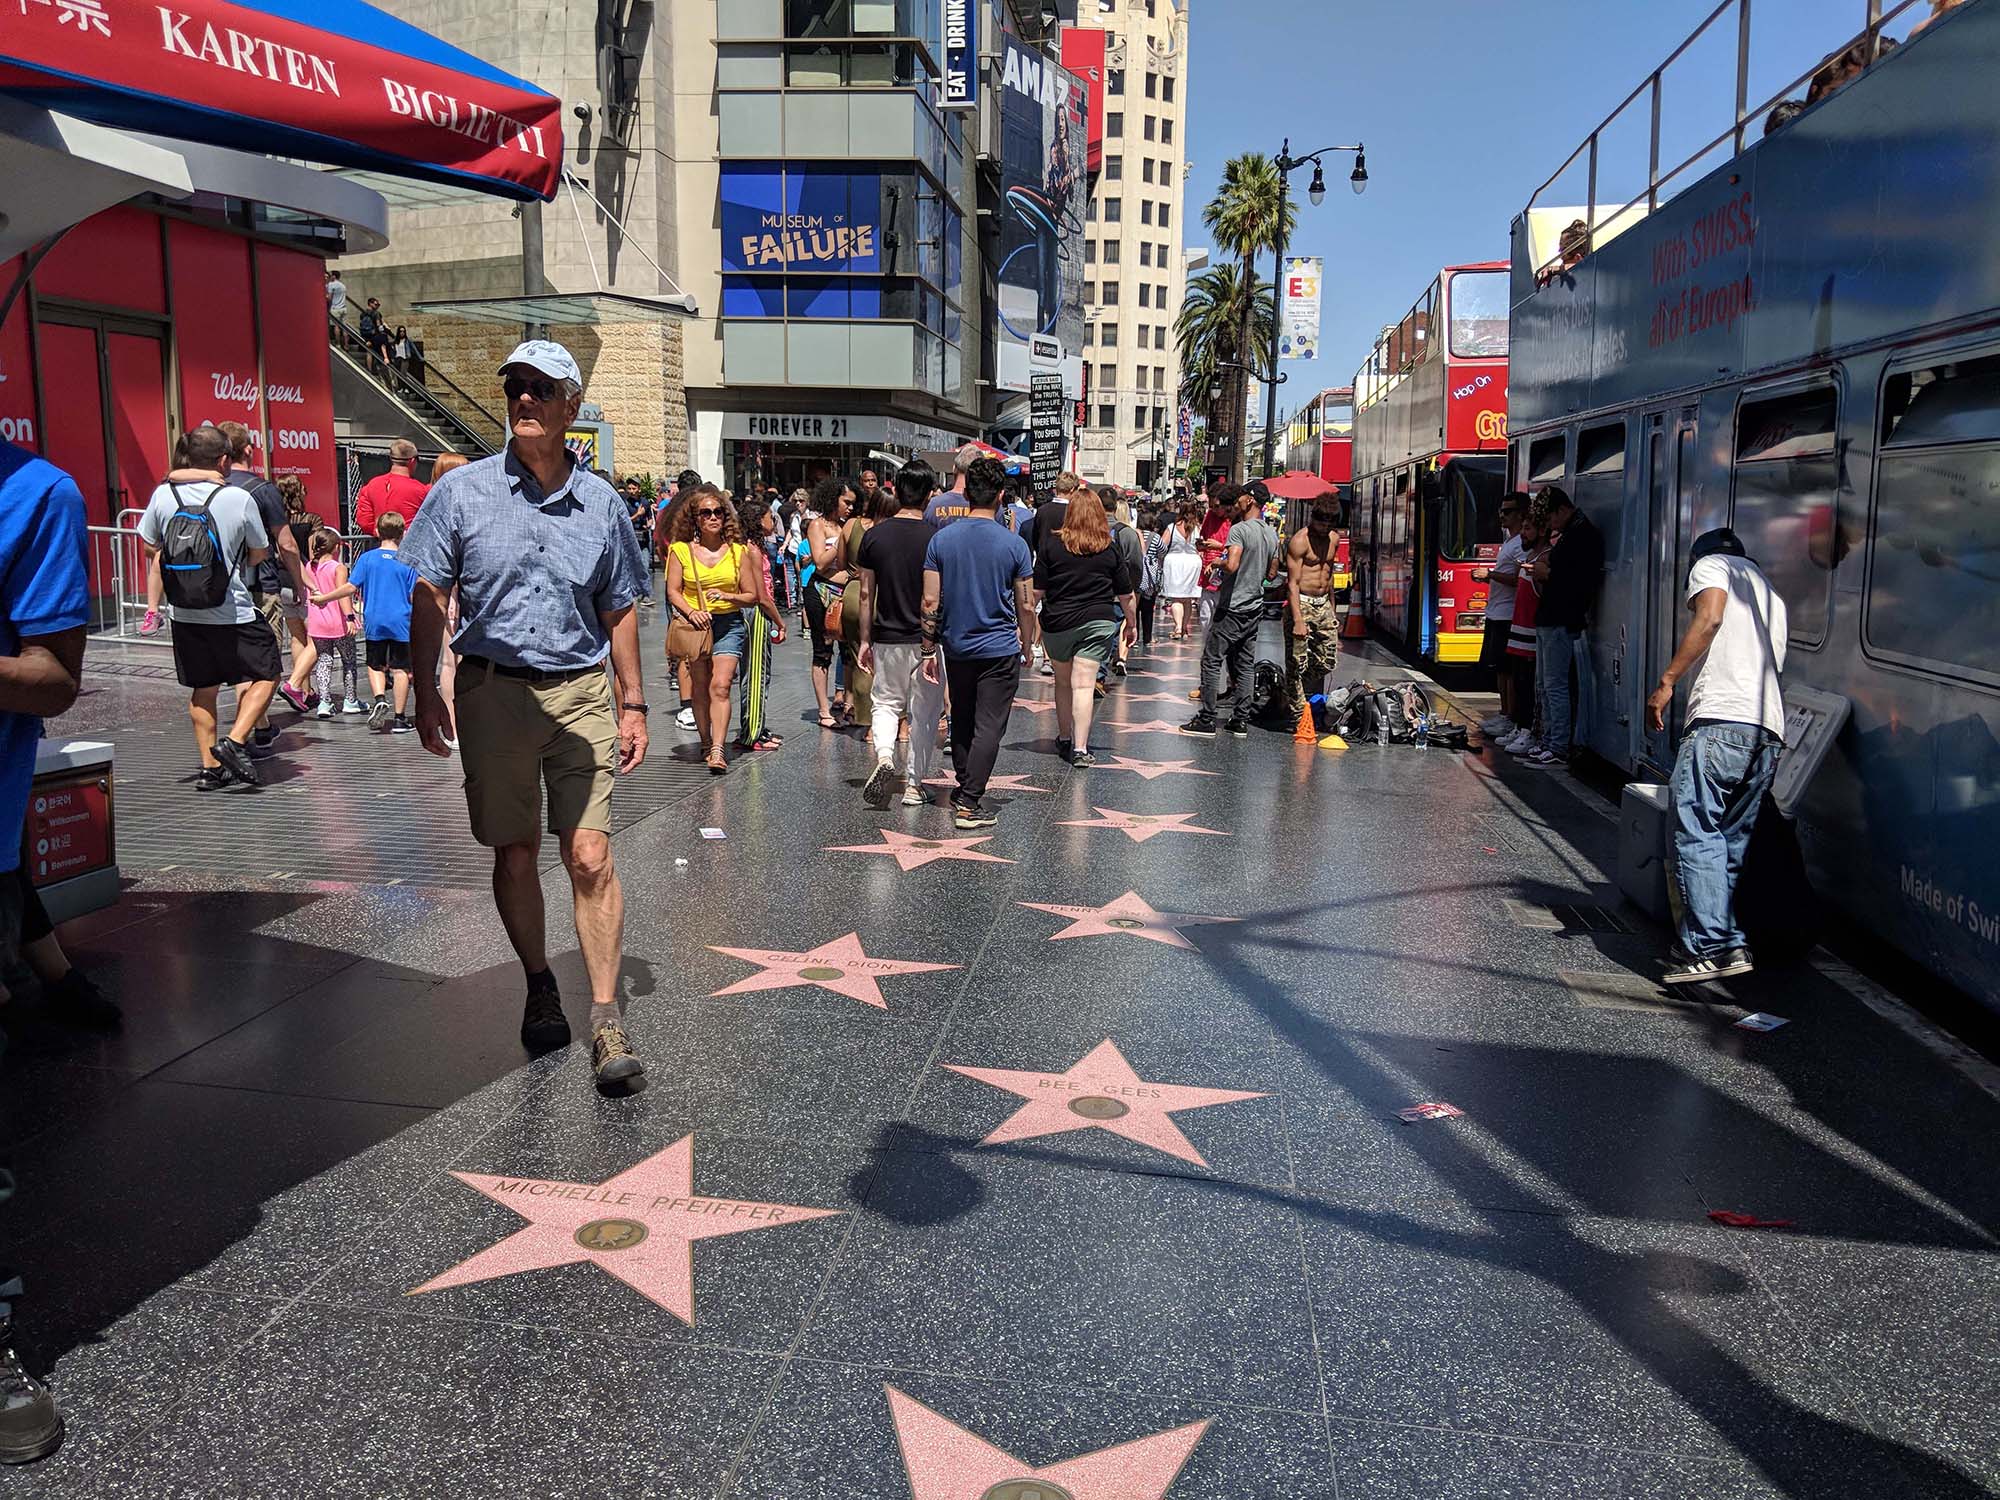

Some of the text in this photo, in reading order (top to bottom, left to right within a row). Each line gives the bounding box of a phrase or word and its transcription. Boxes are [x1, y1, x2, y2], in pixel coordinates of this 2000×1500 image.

[154, 5, 341, 98] KARTEN
[947, 68, 966, 98] EAT
[381, 77, 547, 159] BIGLIETTI
[762, 215, 844, 229] MUSEUM OF
[742, 225, 874, 266] FAILURE
[1288, 277, 1317, 298] E3
[211, 372, 305, 412] Walgeens
[1453, 375, 1492, 400] Hop On
[749, 417, 848, 438] FOREVER 21
[278, 428, 320, 450] soon
[1219, 436, 1228, 446] M
[1031, 461, 1046, 471] FEW
[1046, 459, 1061, 468] FIND
[1033, 472, 1046, 481] THE
[1033, 482, 1043, 491] TO
[1437, 569, 1454, 582] 341
[1050, 905, 1100, 915] PENNY
[1901, 863, 2000, 945] Made of Swi
[847, 960, 893, 970] DION
[1038, 1079, 1161, 1099] BEE GEES
[492, 1180, 786, 1222] MICHELLE PFEIFFER
